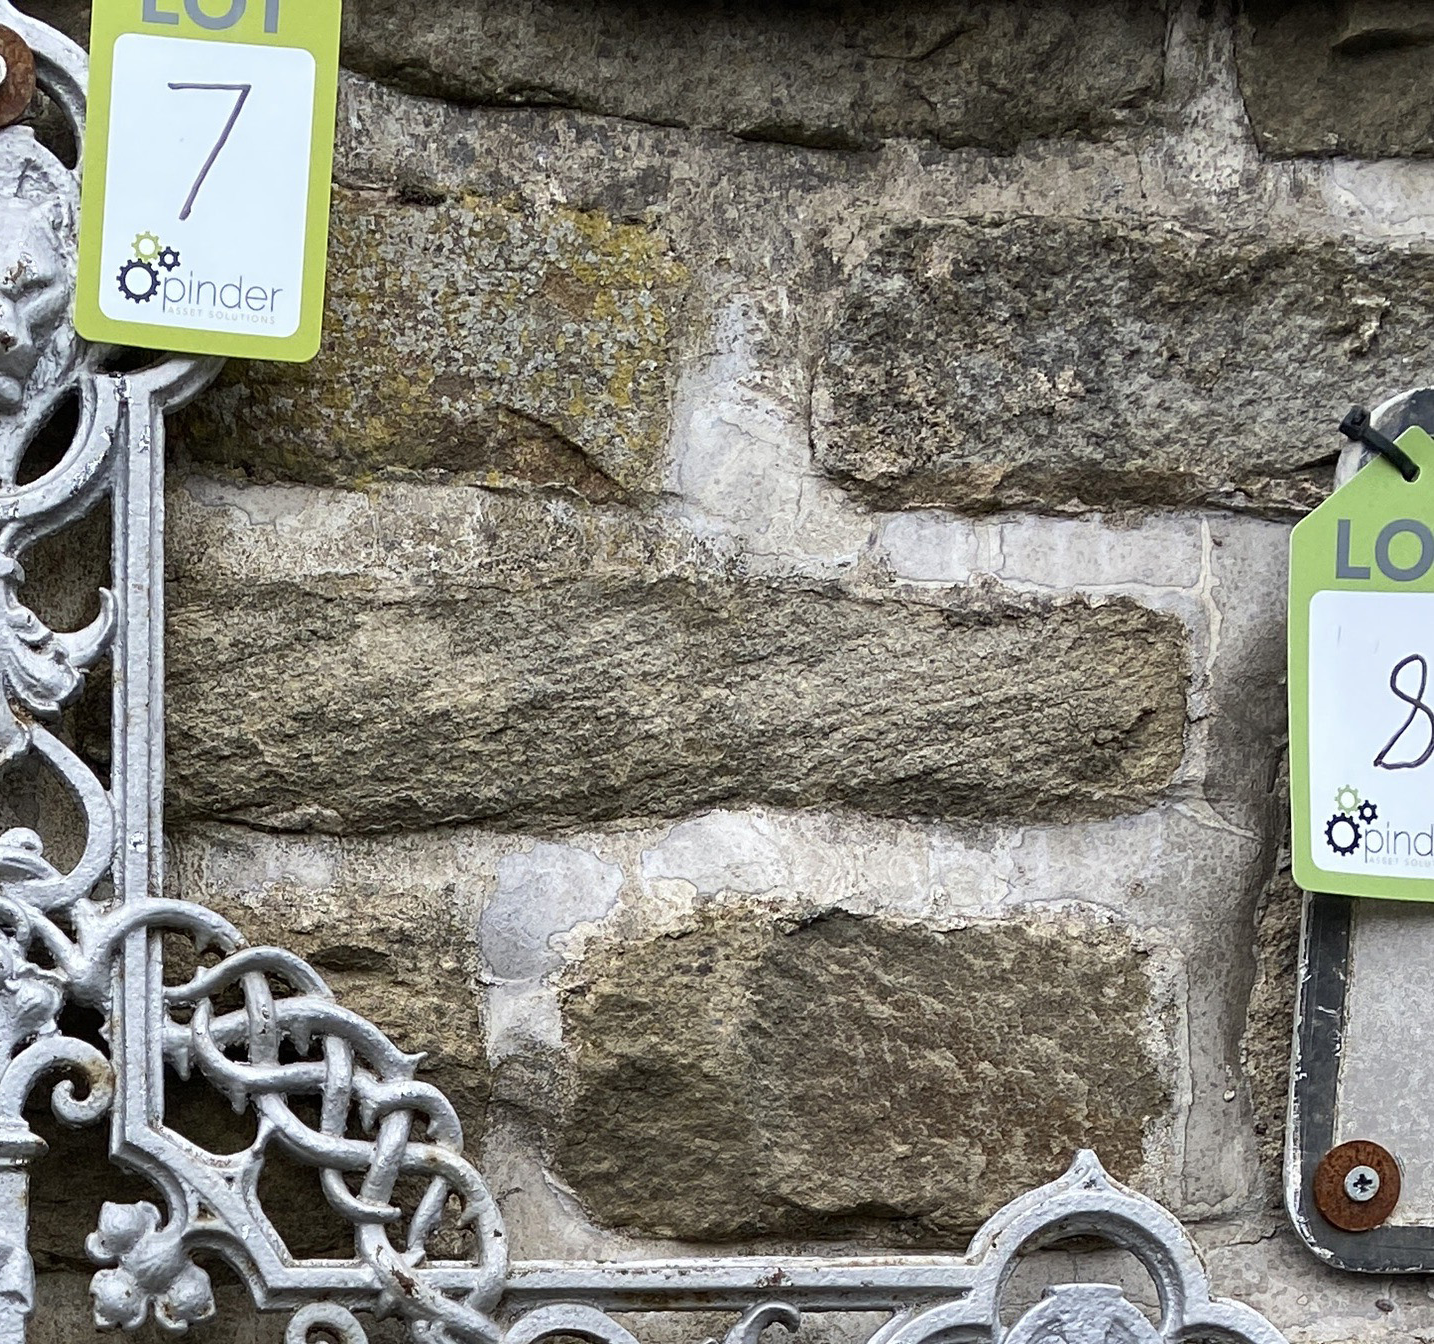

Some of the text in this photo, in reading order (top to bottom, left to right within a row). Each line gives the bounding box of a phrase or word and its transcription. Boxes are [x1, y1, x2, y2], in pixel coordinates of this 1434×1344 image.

[167, 82, 252, 222] 7
[162, 270, 284, 313] pinder
[168, 306, 276, 325] ASSET SOLUTIONS
[1335, 518, 1434, 582] LO
[1373, 653, 1434, 770] 8
